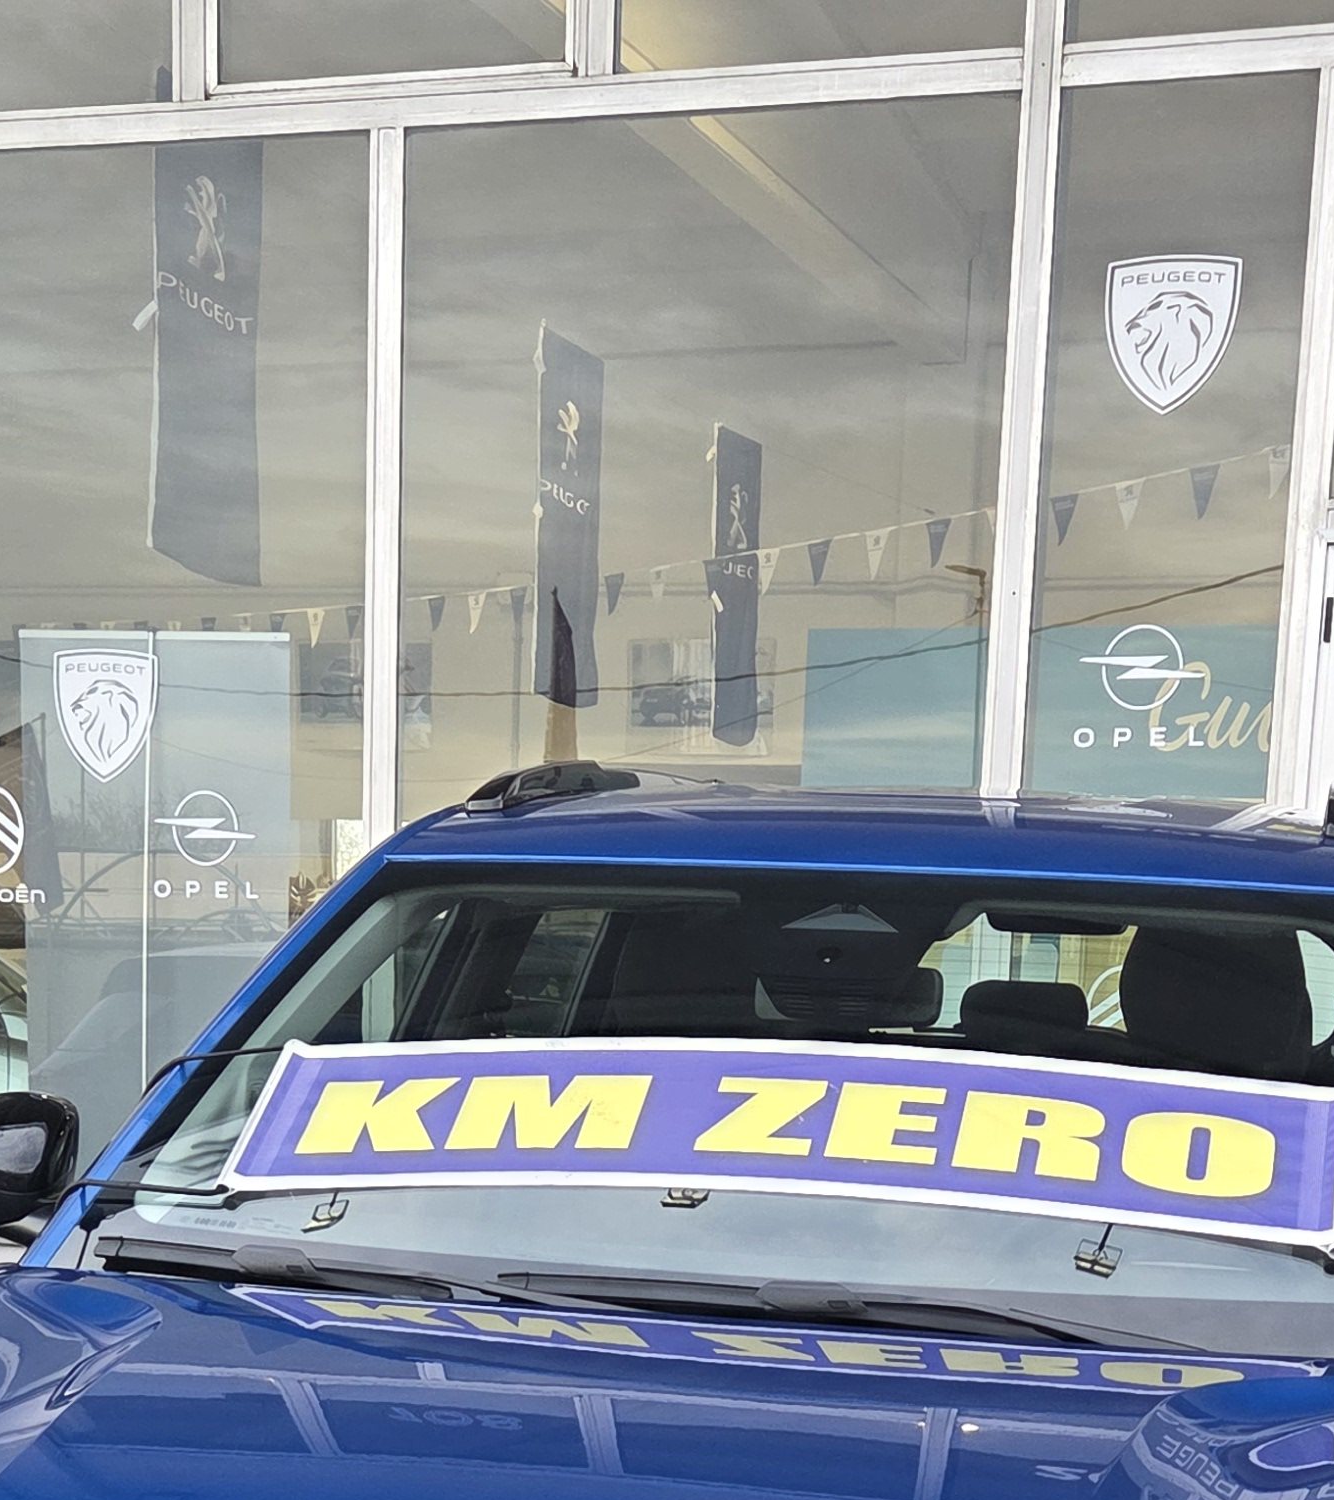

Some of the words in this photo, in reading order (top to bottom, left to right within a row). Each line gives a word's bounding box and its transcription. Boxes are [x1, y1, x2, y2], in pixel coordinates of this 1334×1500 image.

[1120, 270, 1226, 287] PEUGEOT
[65, 663, 147, 675] PEUGEOT
[1072, 727, 1206, 748] OPEL
[154, 879, 261, 901] OPEL
[293, 1074, 653, 1156] KM
[692, 1076, 1278, 1198] ZERO
